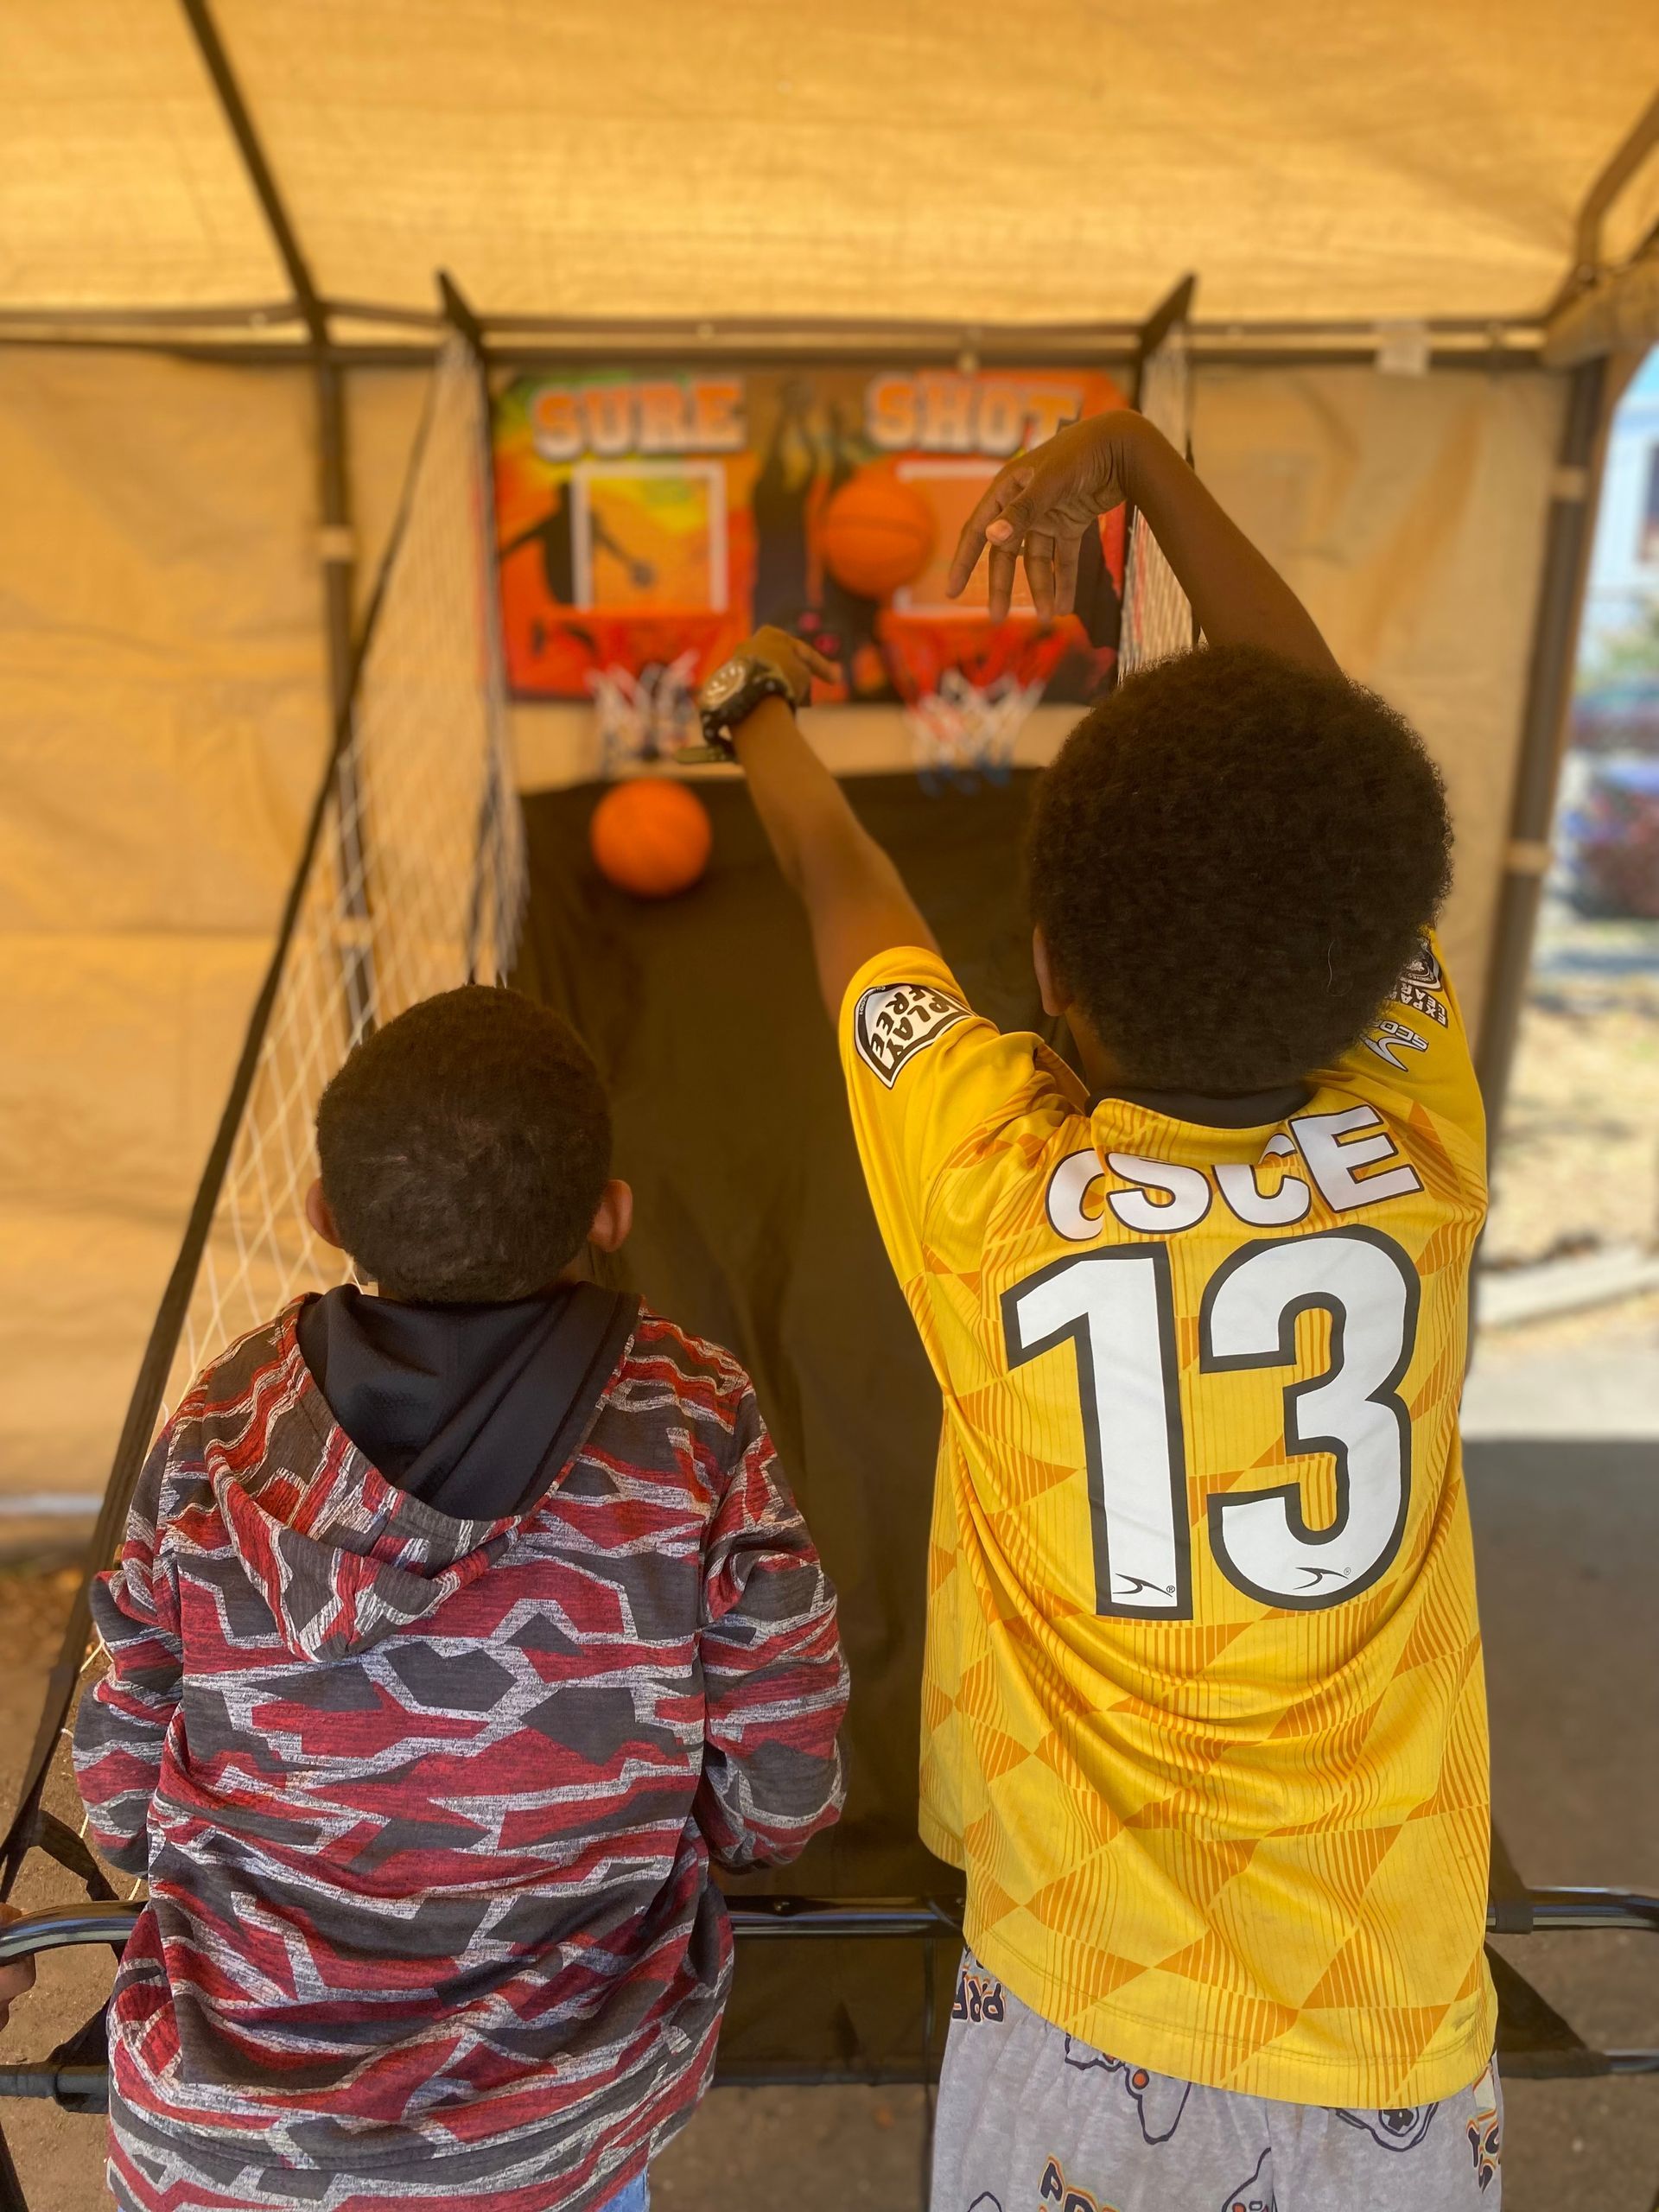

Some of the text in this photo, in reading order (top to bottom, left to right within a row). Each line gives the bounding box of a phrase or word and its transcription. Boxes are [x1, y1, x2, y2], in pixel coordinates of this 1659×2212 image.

[531, 373, 1083, 461] SURE SHOT
[871, 985, 927, 1058] FREE
[886, 996, 950, 1062] PLAY
[1396, 983, 1446, 1015] LEAR
[1046, 1104, 1423, 1243] CSCE
[1000, 1224, 1421, 1620] 13
